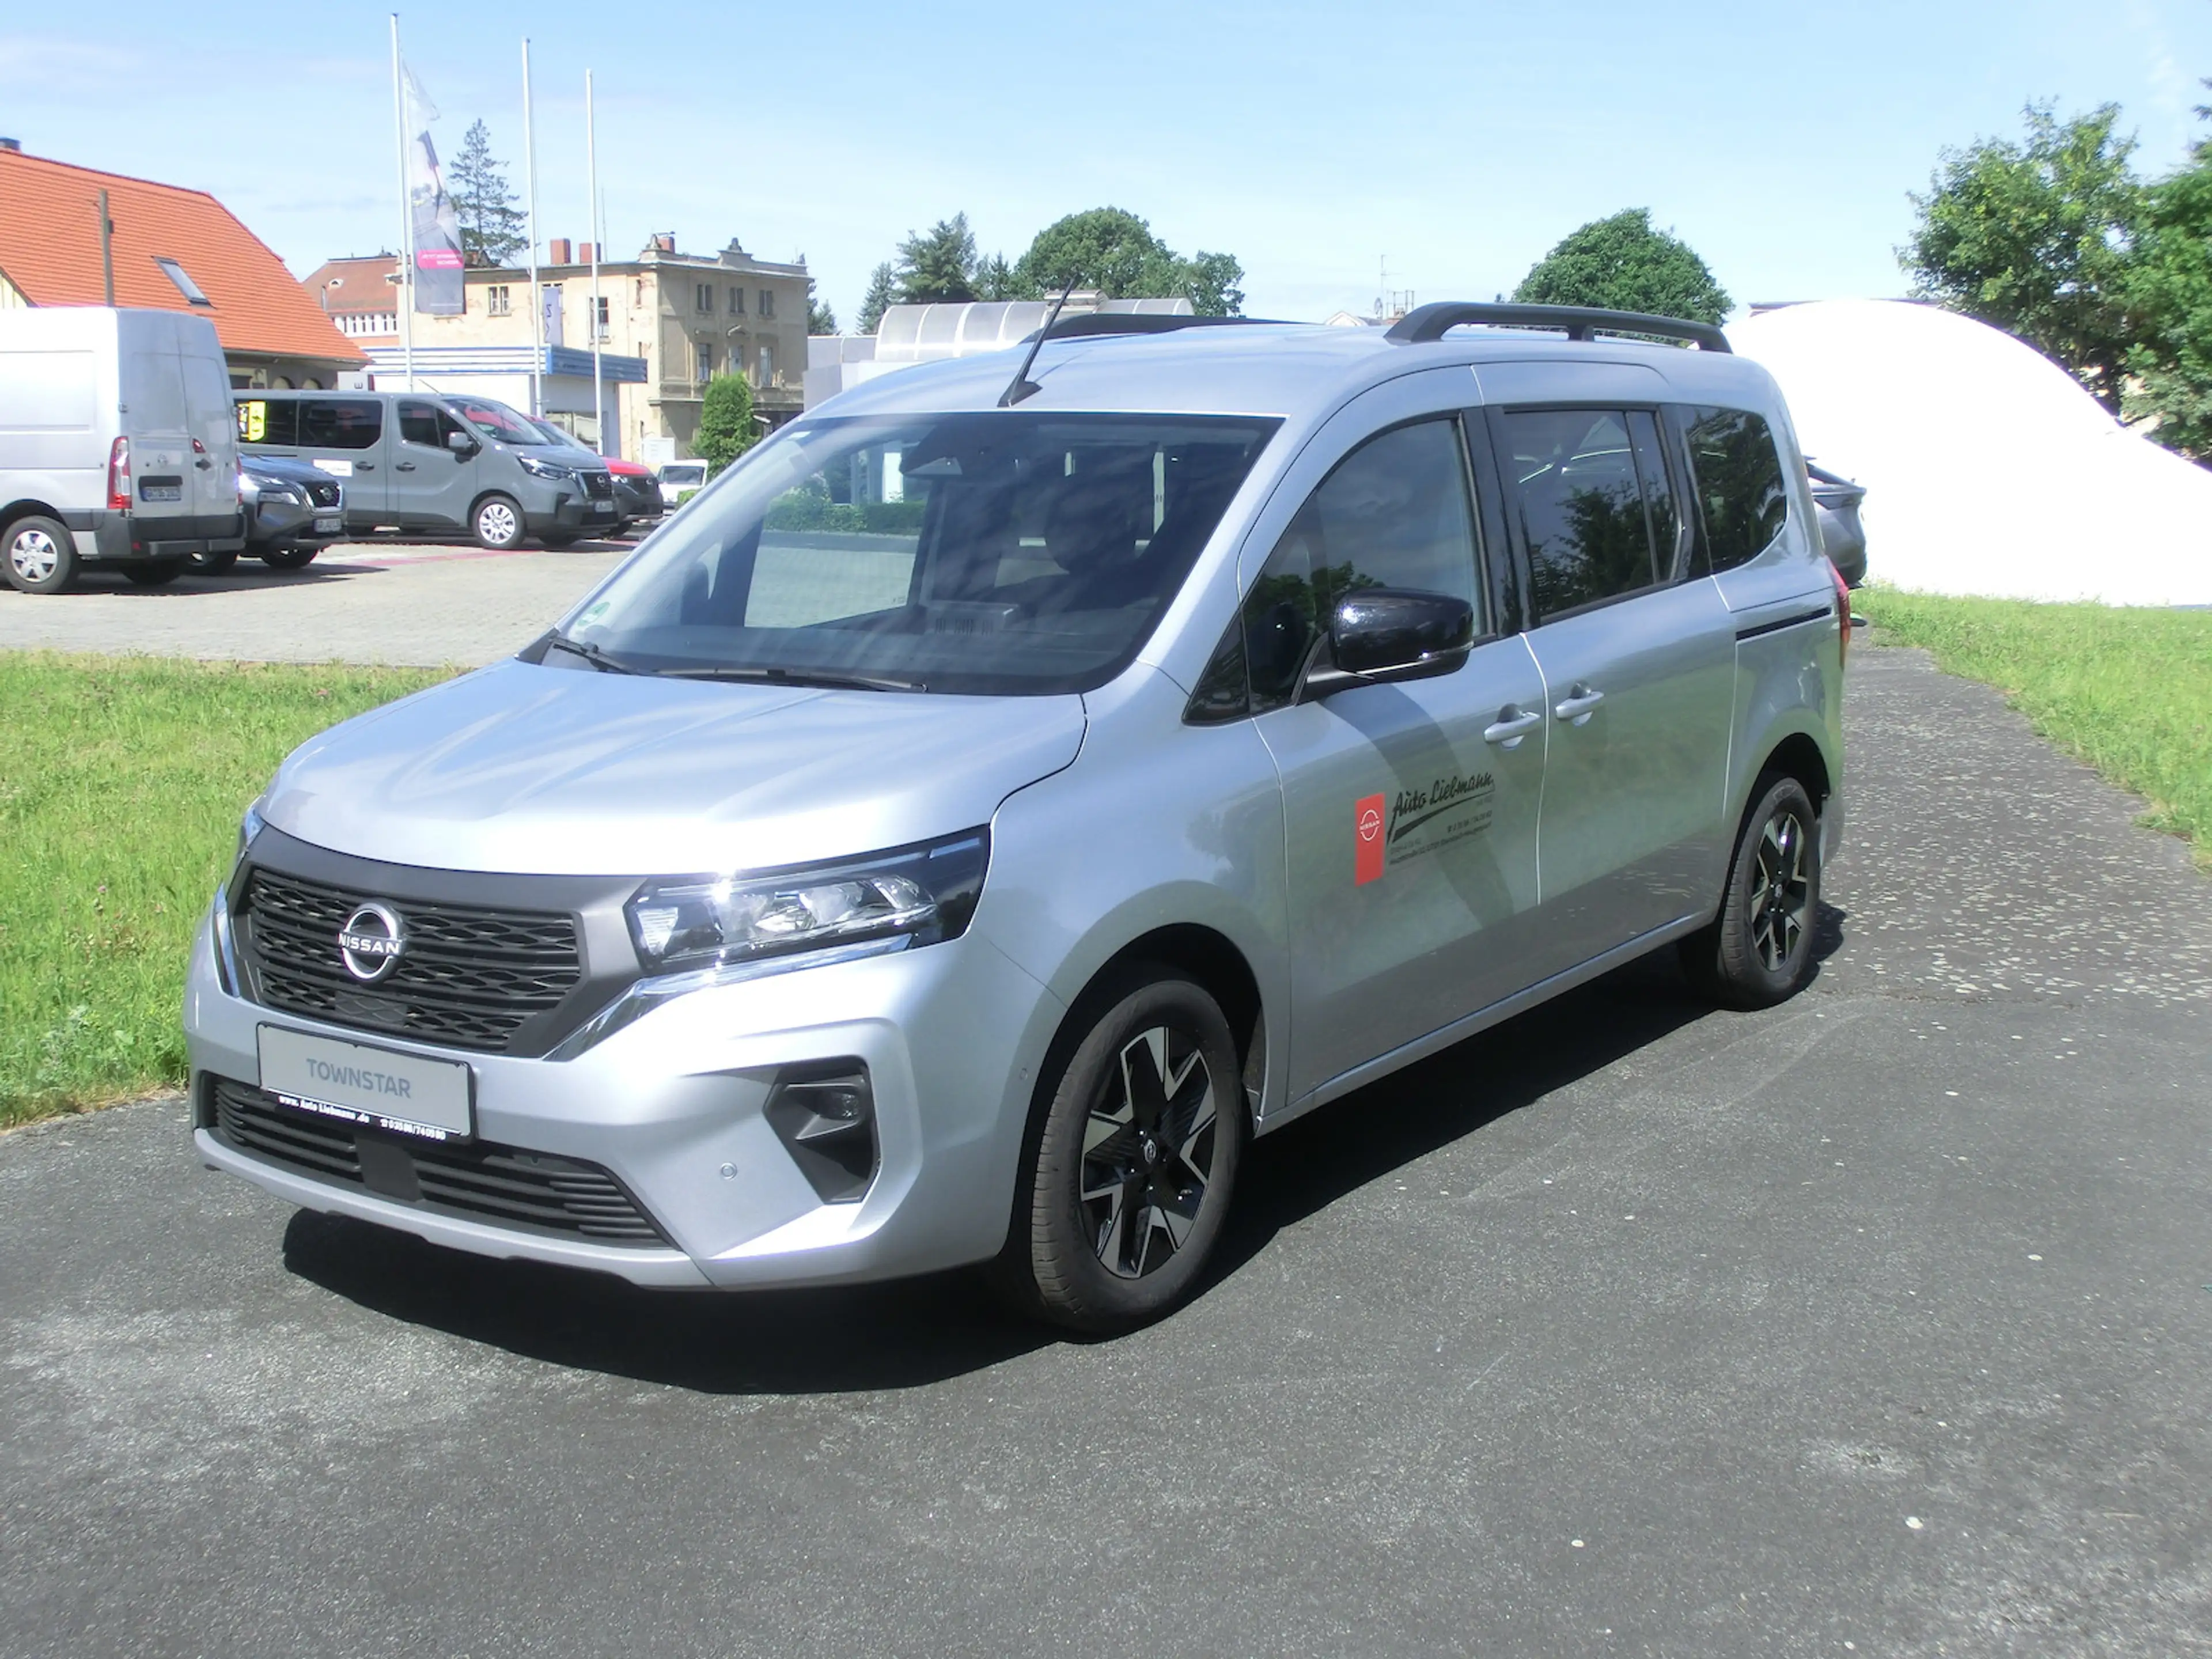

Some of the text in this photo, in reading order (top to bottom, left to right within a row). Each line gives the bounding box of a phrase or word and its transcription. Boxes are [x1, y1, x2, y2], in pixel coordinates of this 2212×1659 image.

[1429, 772, 1494, 805] Liebmann
[338, 933, 400, 955] NISSAN
[306, 1058, 411, 1099] TOWNSTAR
